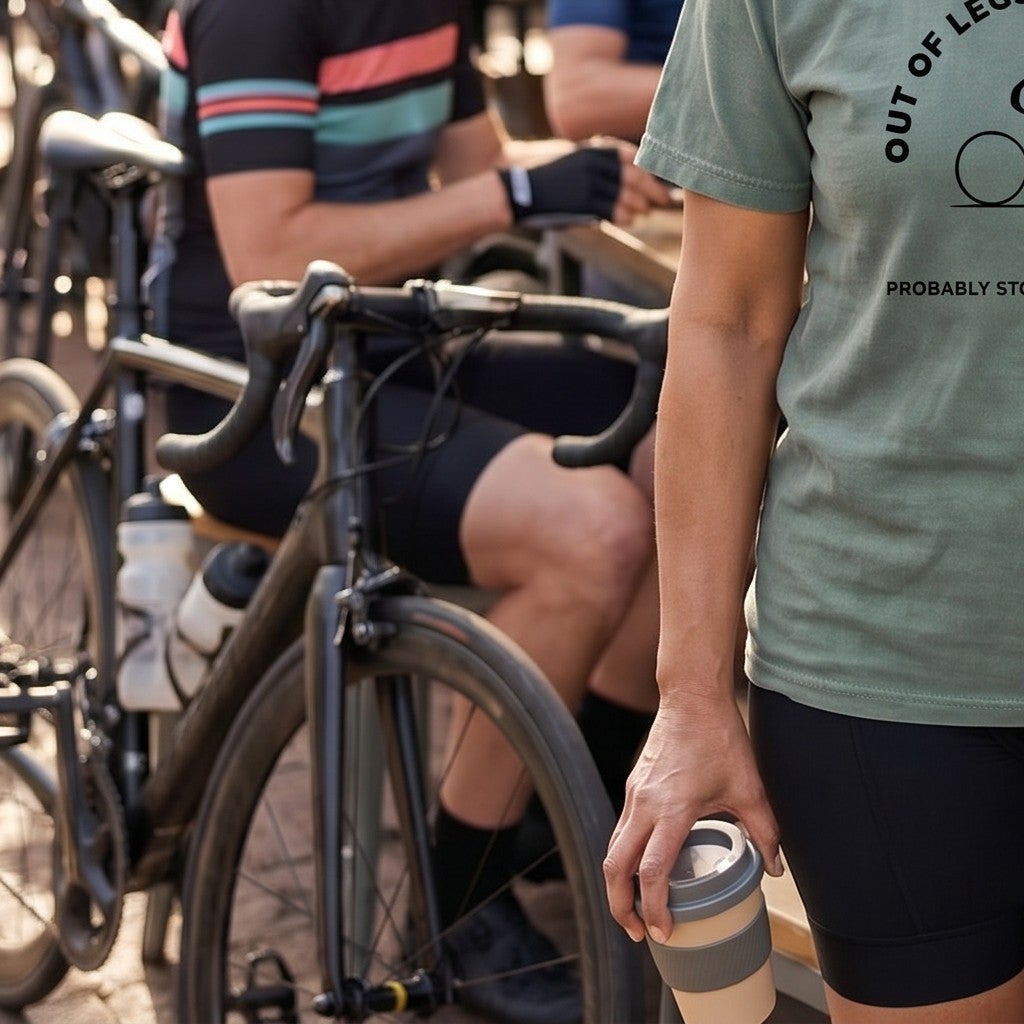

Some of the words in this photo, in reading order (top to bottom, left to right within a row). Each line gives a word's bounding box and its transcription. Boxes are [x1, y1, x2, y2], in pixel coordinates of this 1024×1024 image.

[884, 84, 918, 164] OUT
[907, 30, 943, 78] OF
[886, 280, 991, 296] PROBABLY
